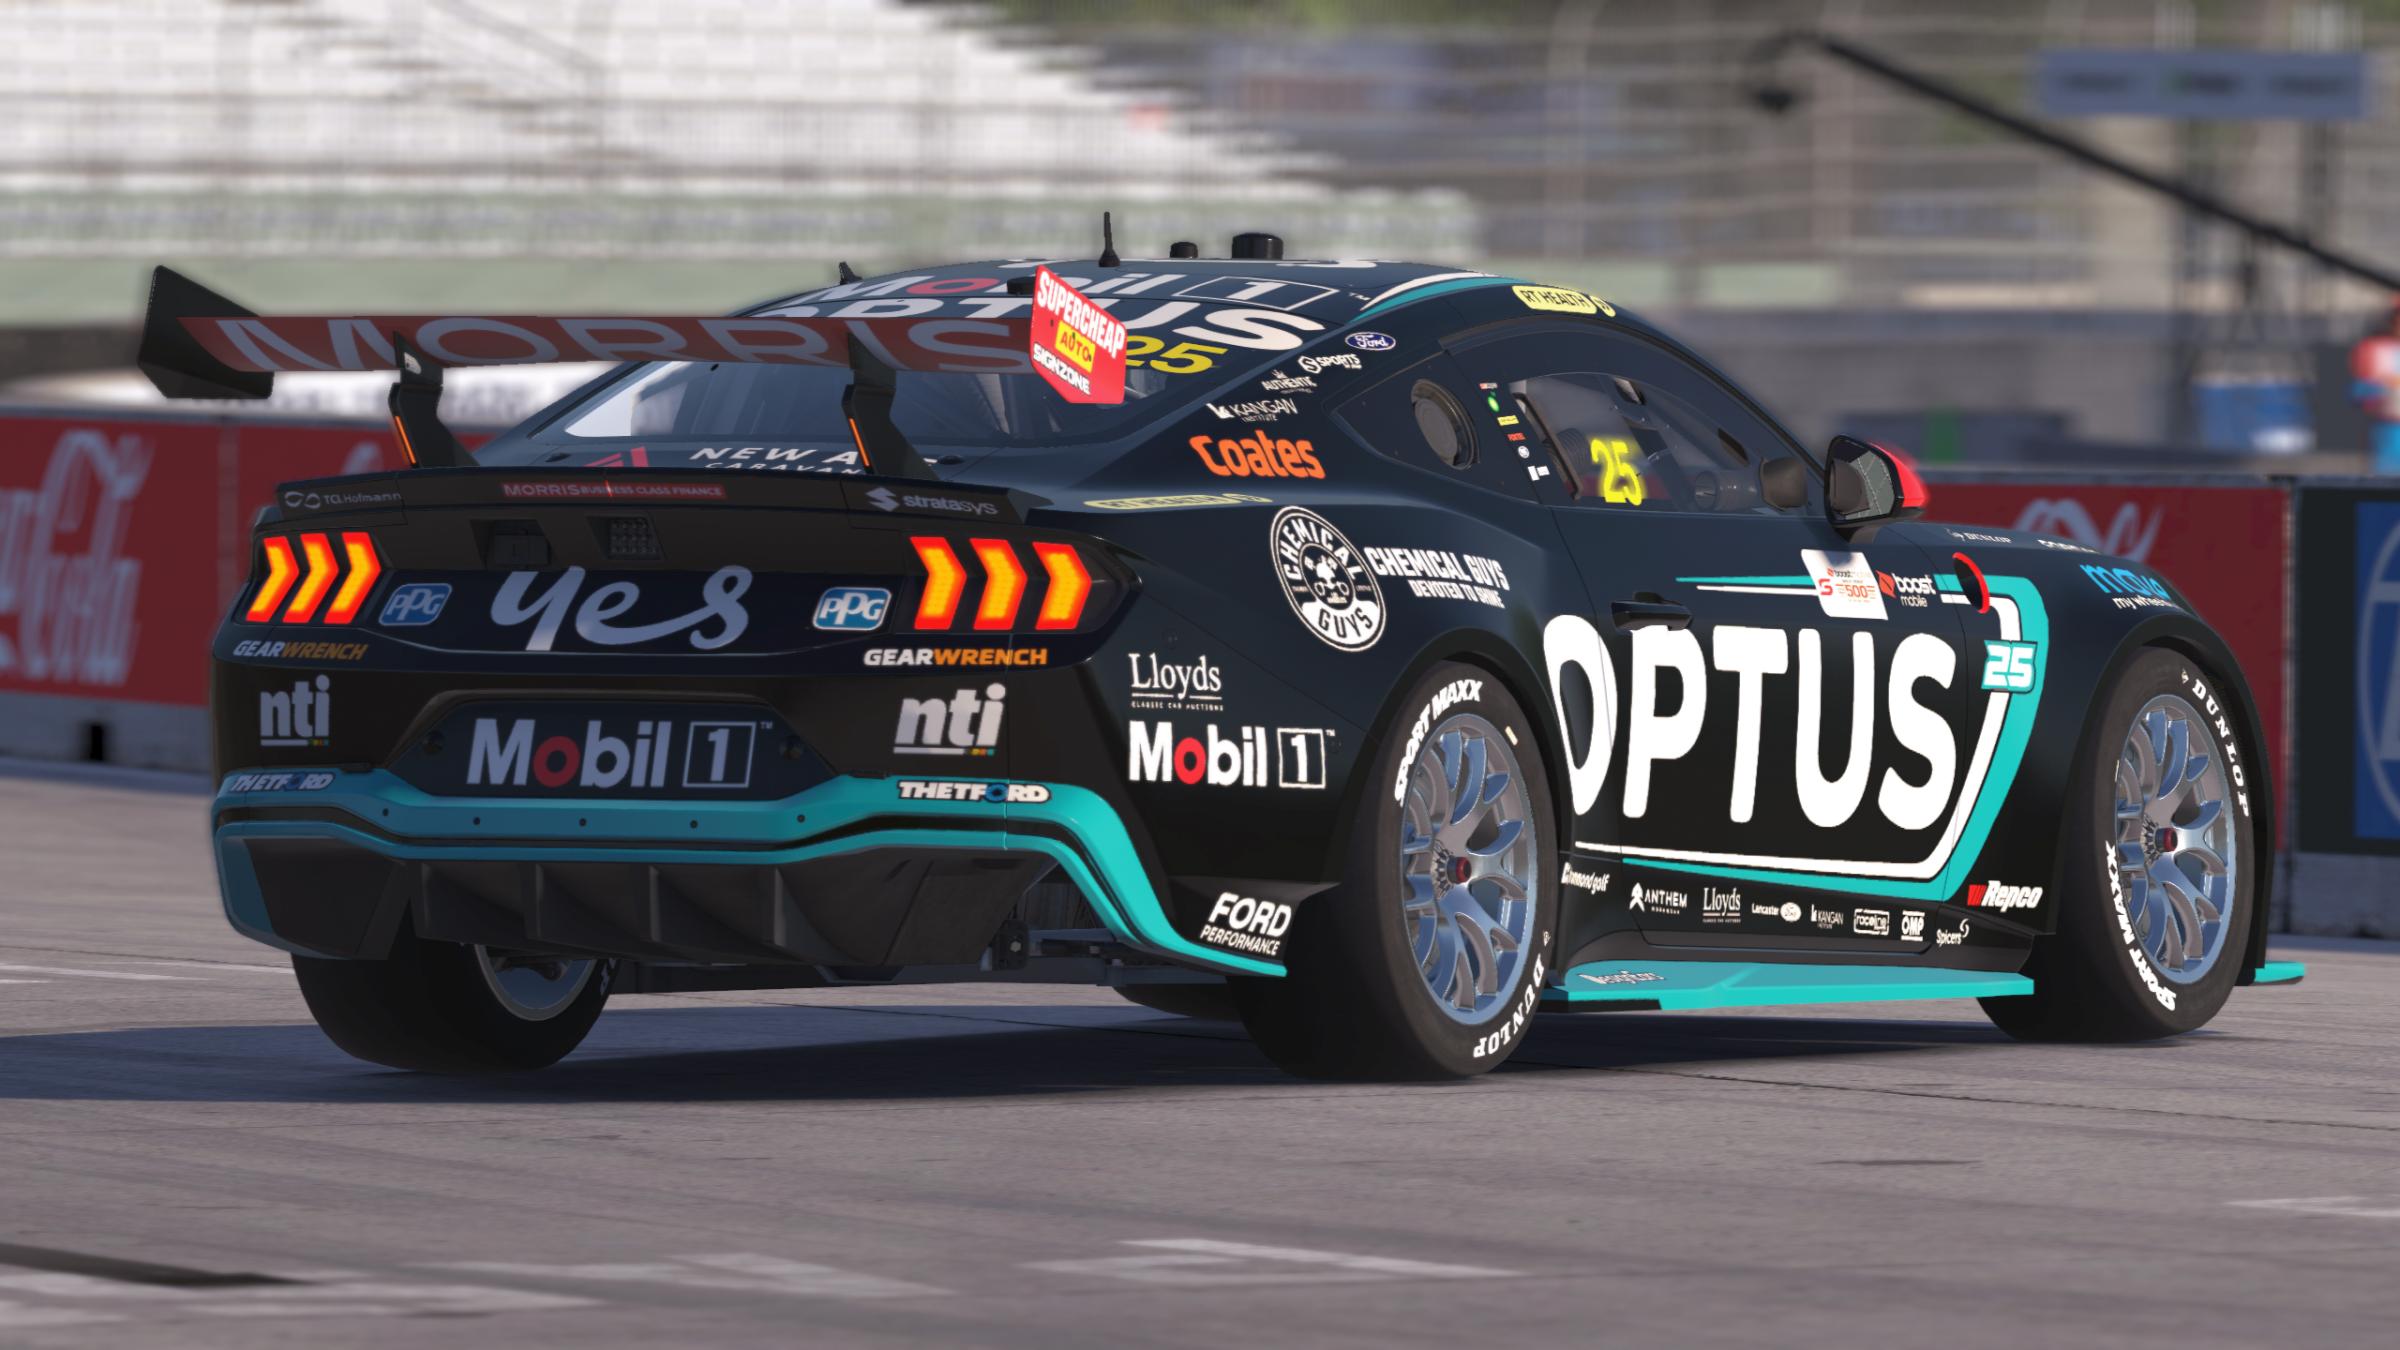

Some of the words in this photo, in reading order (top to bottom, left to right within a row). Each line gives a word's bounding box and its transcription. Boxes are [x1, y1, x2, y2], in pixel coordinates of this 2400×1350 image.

[1227, 281, 1291, 300] 1
[1540, 291, 1591, 308] HEALTH
[1037, 271, 1126, 359] SUPERCHEAP
[215, 317, 1031, 373] MORRIS
[1061, 331, 1092, 362] AUTO
[1126, 335, 1229, 374] 25
[1354, 334, 1388, 348] Ford
[1033, 343, 1092, 396] SIGNZONE
[1316, 353, 1361, 367] SPORTS
[1229, 398, 1298, 416] KANGAN
[689, 447, 819, 460] NEW
[1189, 427, 1326, 479] Coates
[1590, 438, 1642, 505] 25
[344, 492, 402, 504] Hofmann
[503, 484, 580, 496] MORRIS
[636, 486, 671, 495] CLASS
[672, 487, 723, 496] FINANCE
[903, 495, 998, 515] stratasys
[1280, 518, 1363, 580] CHEMICAL
[1363, 546, 1473, 582] CHEMICAL
[1463, 554, 1511, 591] GUYS
[1891, 573, 1936, 595] boost
[385, 587, 446, 621] PPG
[1407, 579, 1465, 600] DEVOTED
[1459, 584, 1479, 602] TO
[1844, 584, 1868, 599] 500
[1900, 595, 1928, 607] mobile
[2112, 597, 2137, 610] my
[490, 565, 754, 651] yes
[820, 593, 885, 625] PPG
[1319, 607, 1373, 638] GUYS
[232, 639, 369, 661] GEARWRENCH
[863, 648, 1049, 667] GEARWRENCH
[1128, 652, 1222, 699] Lloyds
[1985, 643, 2034, 689] 25
[260, 674, 331, 738] nti
[894, 682, 1007, 747] nti
[1185, 702, 1225, 712] AUCTIONS
[1543, 614, 1957, 831] OPTUS
[467, 718, 672, 788] Mobil
[1129, 720, 1268, 787] Mobil
[1394, 703, 1430, 808] SPORT
[1431, 678, 1483, 721] MAXX
[2192, 679, 2250, 817] DUNLOP
[231, 773, 335, 793] THETFORD
[898, 780, 1050, 803] THETFORD
[1644, 888, 1688, 909] ANTHEM
[1703, 887, 1741, 916] Lloyds
[1981, 880, 2044, 913] Repco
[2105, 840, 2135, 945] MAXX
[1208, 891, 1292, 937] FORD
[1751, 903, 1779, 916] Lancaster
[1818, 910, 1844, 925] KANGAN
[1200, 924, 1281, 956] PERFORMANCE
[1901, 917, 1925, 937] OMP
[1936, 929, 1963, 948] Spicers
[2129, 948, 2177, 1012] SPORT
[1473, 953, 1545, 1059] DUNLOP
